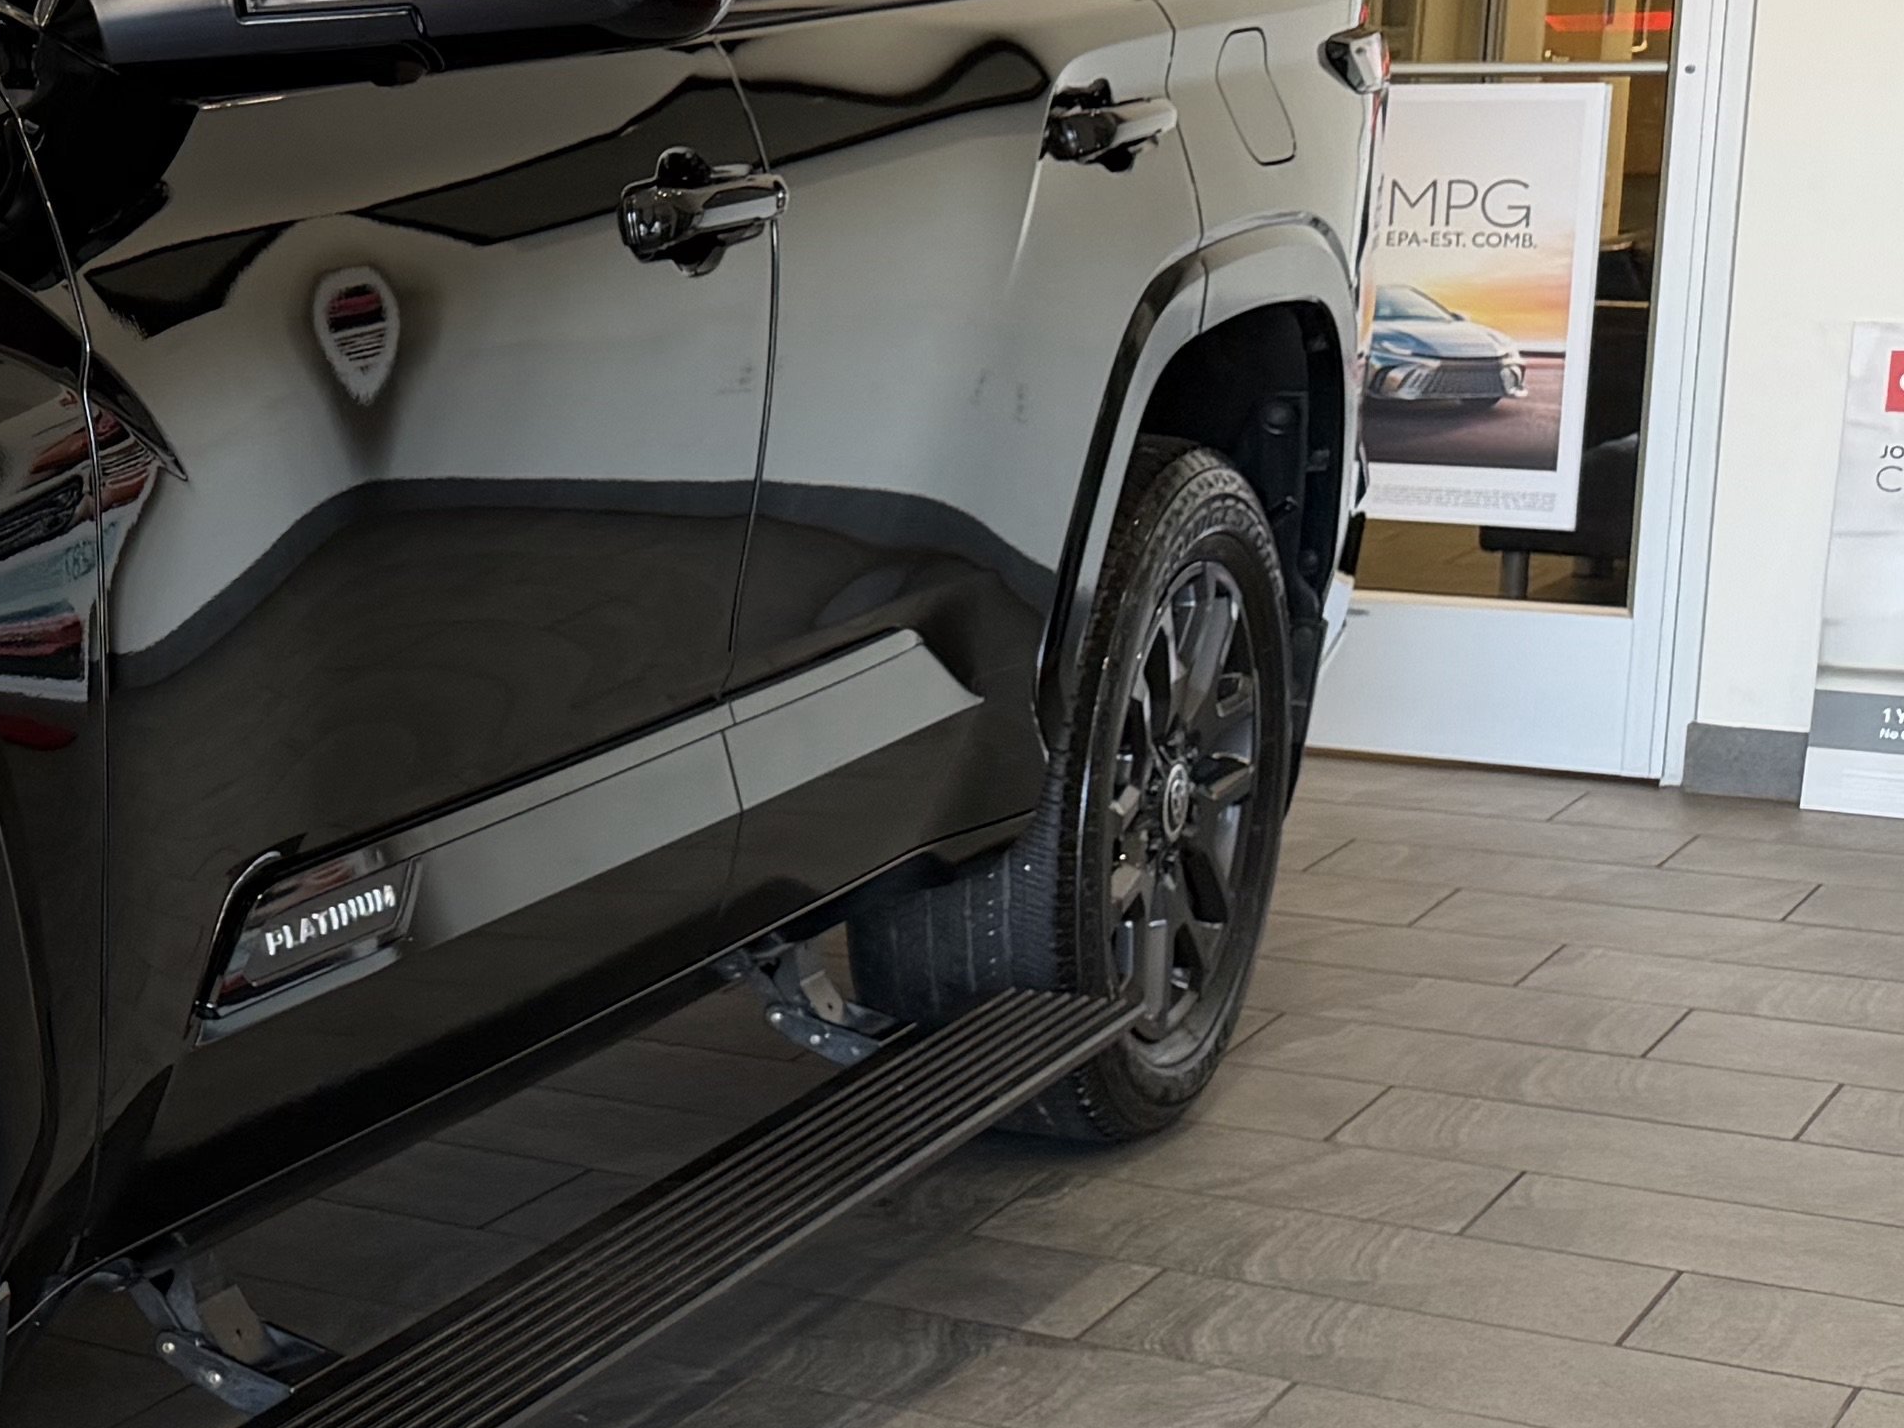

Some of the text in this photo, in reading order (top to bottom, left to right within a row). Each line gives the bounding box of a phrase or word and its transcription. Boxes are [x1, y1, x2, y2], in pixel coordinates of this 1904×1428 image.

[1388, 179, 1531, 228] MPG
[1385, 231, 1537, 249] EPA-EST. COMB.
[264, 884, 396, 956] PLATINUM
